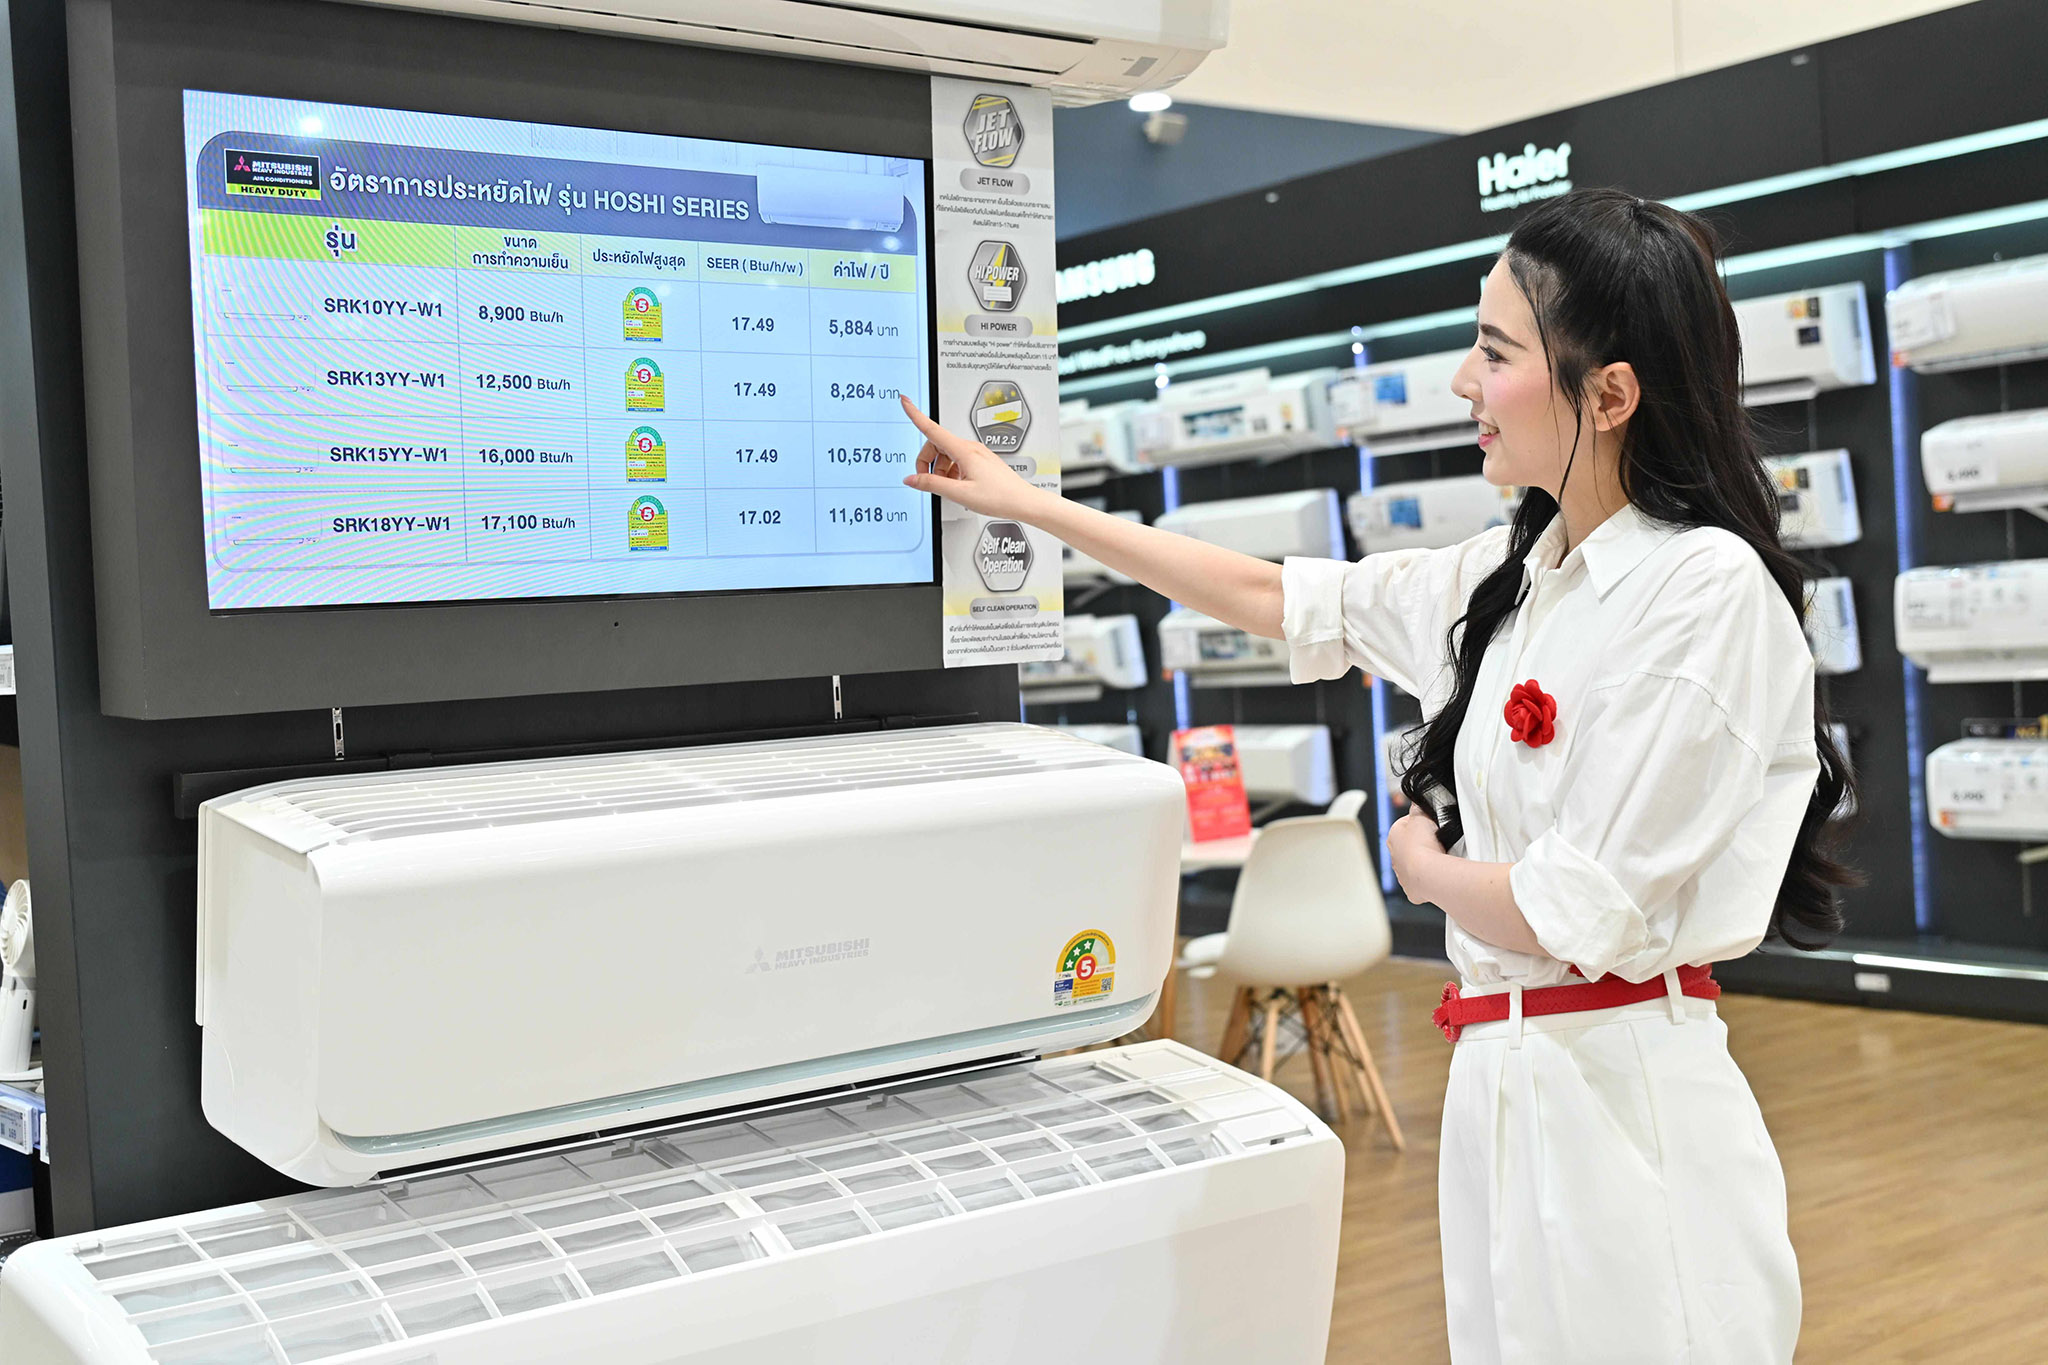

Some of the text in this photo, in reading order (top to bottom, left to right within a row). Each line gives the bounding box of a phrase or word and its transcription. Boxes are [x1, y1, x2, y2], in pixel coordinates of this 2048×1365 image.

[977, 109, 1010, 134] JET
[974, 127, 1013, 155] FLOW
[252, 161, 312, 172] MITSUBISHI
[1478, 142, 1572, 196] Haier
[265, 176, 313, 185] CONDITIONERS
[977, 177, 1014, 187] JET FLOW
[241, 186, 307, 197] HEAVY DUTY
[330, 166, 750, 221] อัตราการประหยัดไฟ รุ่น HOSHI SERIES
[326, 225, 357, 257] รุ่น
[504, 235, 537, 249] ขนาด
[472, 252, 569, 270] การทำความเย็น
[592, 248, 686, 269] ประหยัดไฟสูงสุด
[706, 257, 739, 270] SEER
[833, 260, 866, 279] ค่าไฟ
[880, 263, 889, 280] ปี
[975, 265, 1020, 281] HI POWER
[324, 298, 443, 317] SRK10YY-W1
[478, 305, 564, 323] 8,900 Btu/h
[638, 300, 647, 311] 5
[732, 316, 775, 332] 17.49
[828, 320, 899, 337] 5,884 บาท
[981, 322, 1017, 331] HI POWER
[327, 370, 446, 388] SRK13YY-W1
[476, 374, 571, 392] 12,500 Btu/h
[639, 370, 649, 382] 5
[734, 382, 776, 397] 17.49
[830, 383, 901, 400] 8,264 บาท
[641, 440, 651, 451] 5
[985, 435, 1017, 445] PM 2.5
[330, 446, 448, 463] SRK15YY-W1
[479, 449, 573, 466] 16,000 Btu/h
[736, 449, 778, 464] 17.49
[828, 447, 907, 465] 10,578 บาท
[643, 508, 653, 520] 5
[739, 510, 781, 525] 17.02
[829, 507, 908, 524] 11,618 บาท
[333, 516, 450, 533] SRK18YY-W1
[481, 515, 576, 532] 17,100 Btu/h
[981, 537, 1026, 554] Self Clean
[982, 556, 1024, 577] Operation
[1006, 604, 1037, 612] OPERATION
[776, 938, 870, 961] MITSUBISHI
[775, 950, 869, 970] HEAVY INDUSTRIES
[1080, 959, 1092, 977] 5
